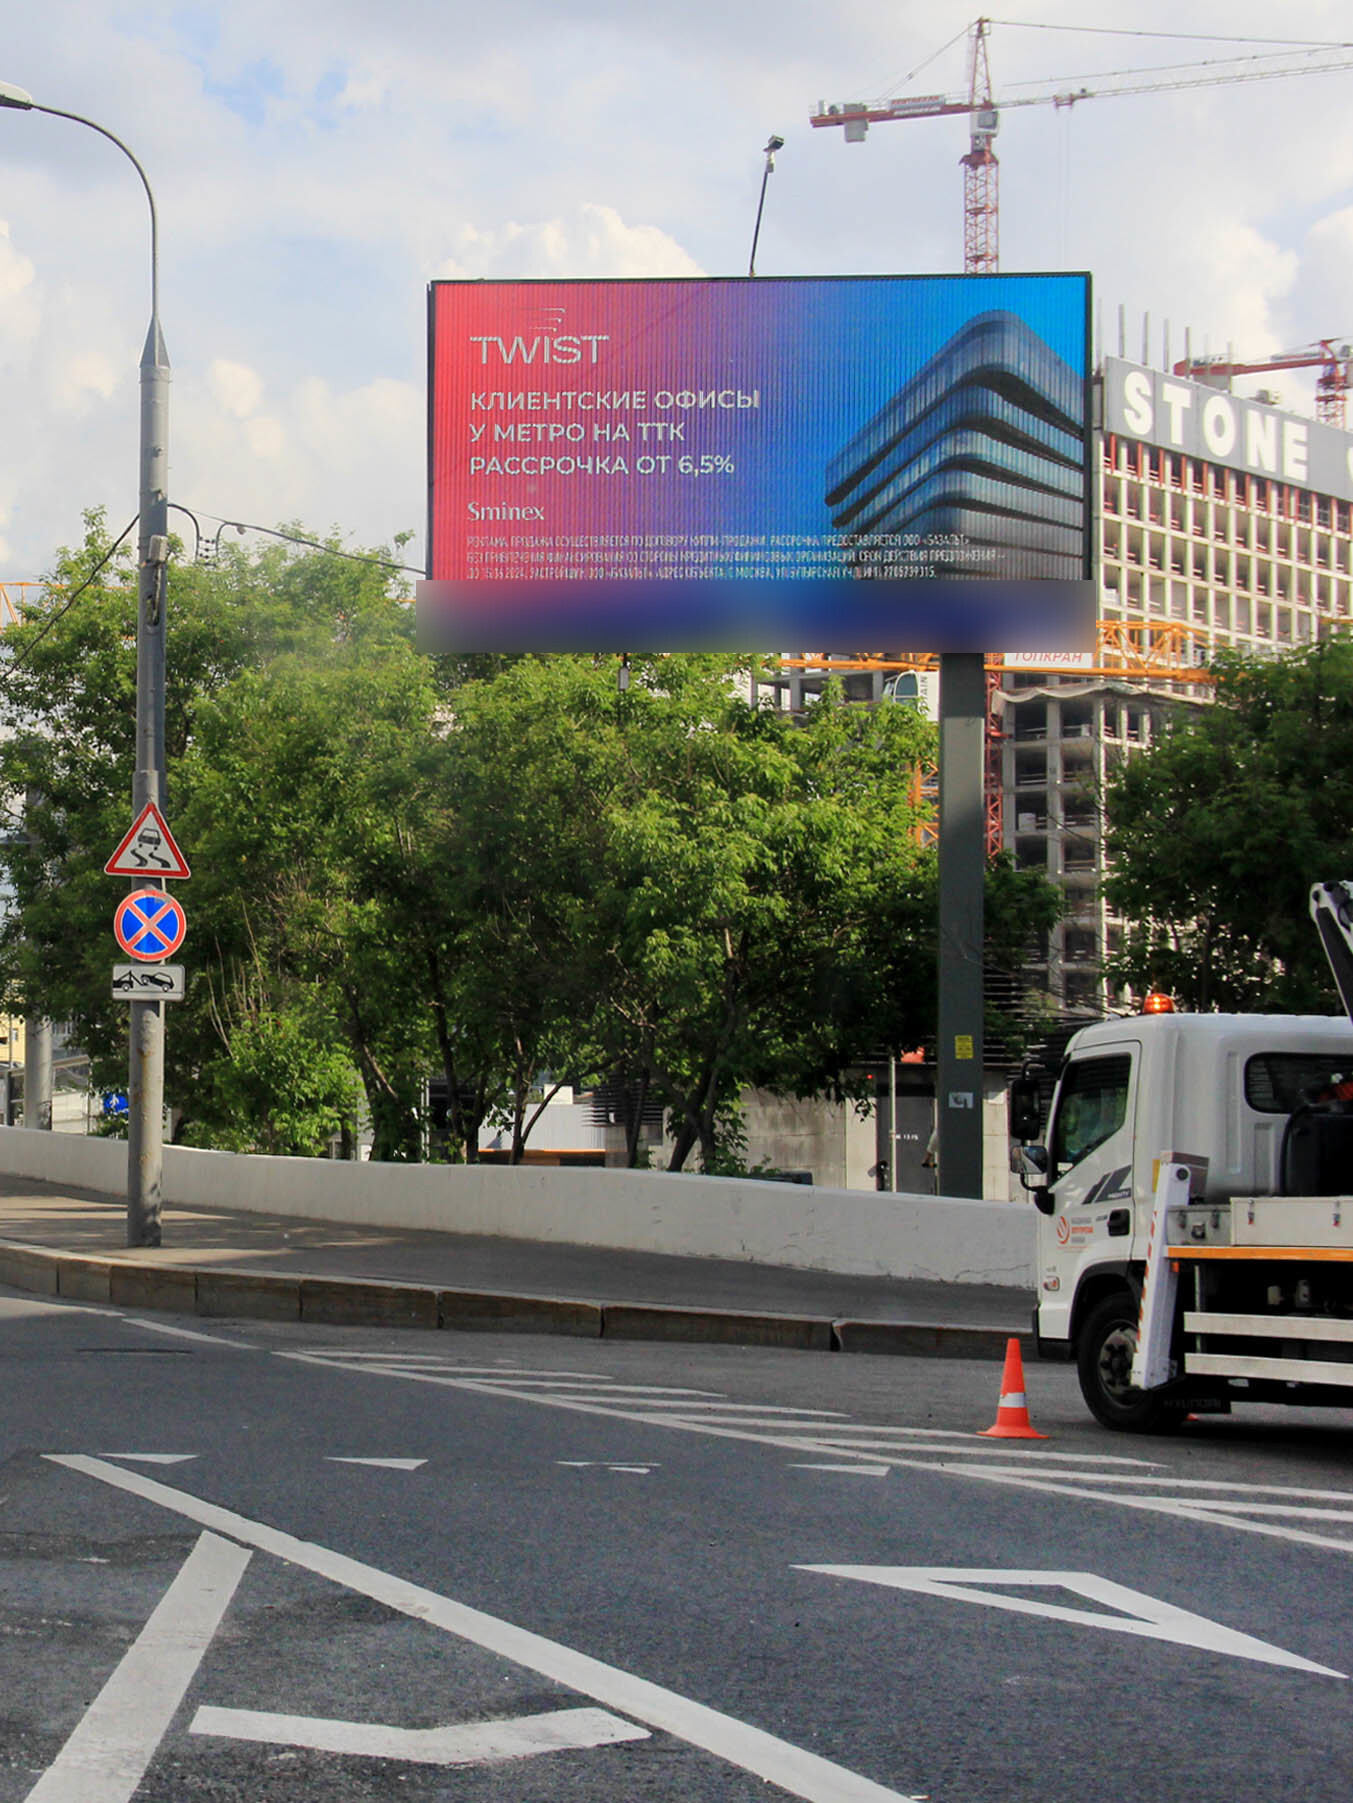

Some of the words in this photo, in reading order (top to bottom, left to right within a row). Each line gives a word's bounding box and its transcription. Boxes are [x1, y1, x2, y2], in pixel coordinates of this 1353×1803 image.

[470, 335, 609, 364] TWIST
[470, 391, 646, 411] КЛИЕНТСКИЕ
[654, 389, 760, 409] ОФИСЫ
[469, 423, 486, 442] У
[493, 423, 585, 442] МЕТРО
[594, 422, 630, 442] НА
[637, 421, 686, 441] ТТК
[1123, 370, 1308, 482] STONE
[470, 455, 630, 475] РАССРОЧКА
[636, 455, 671, 475] ОТ
[678, 454, 735, 478] 6,5%
[467, 501, 545, 521] Sminex
